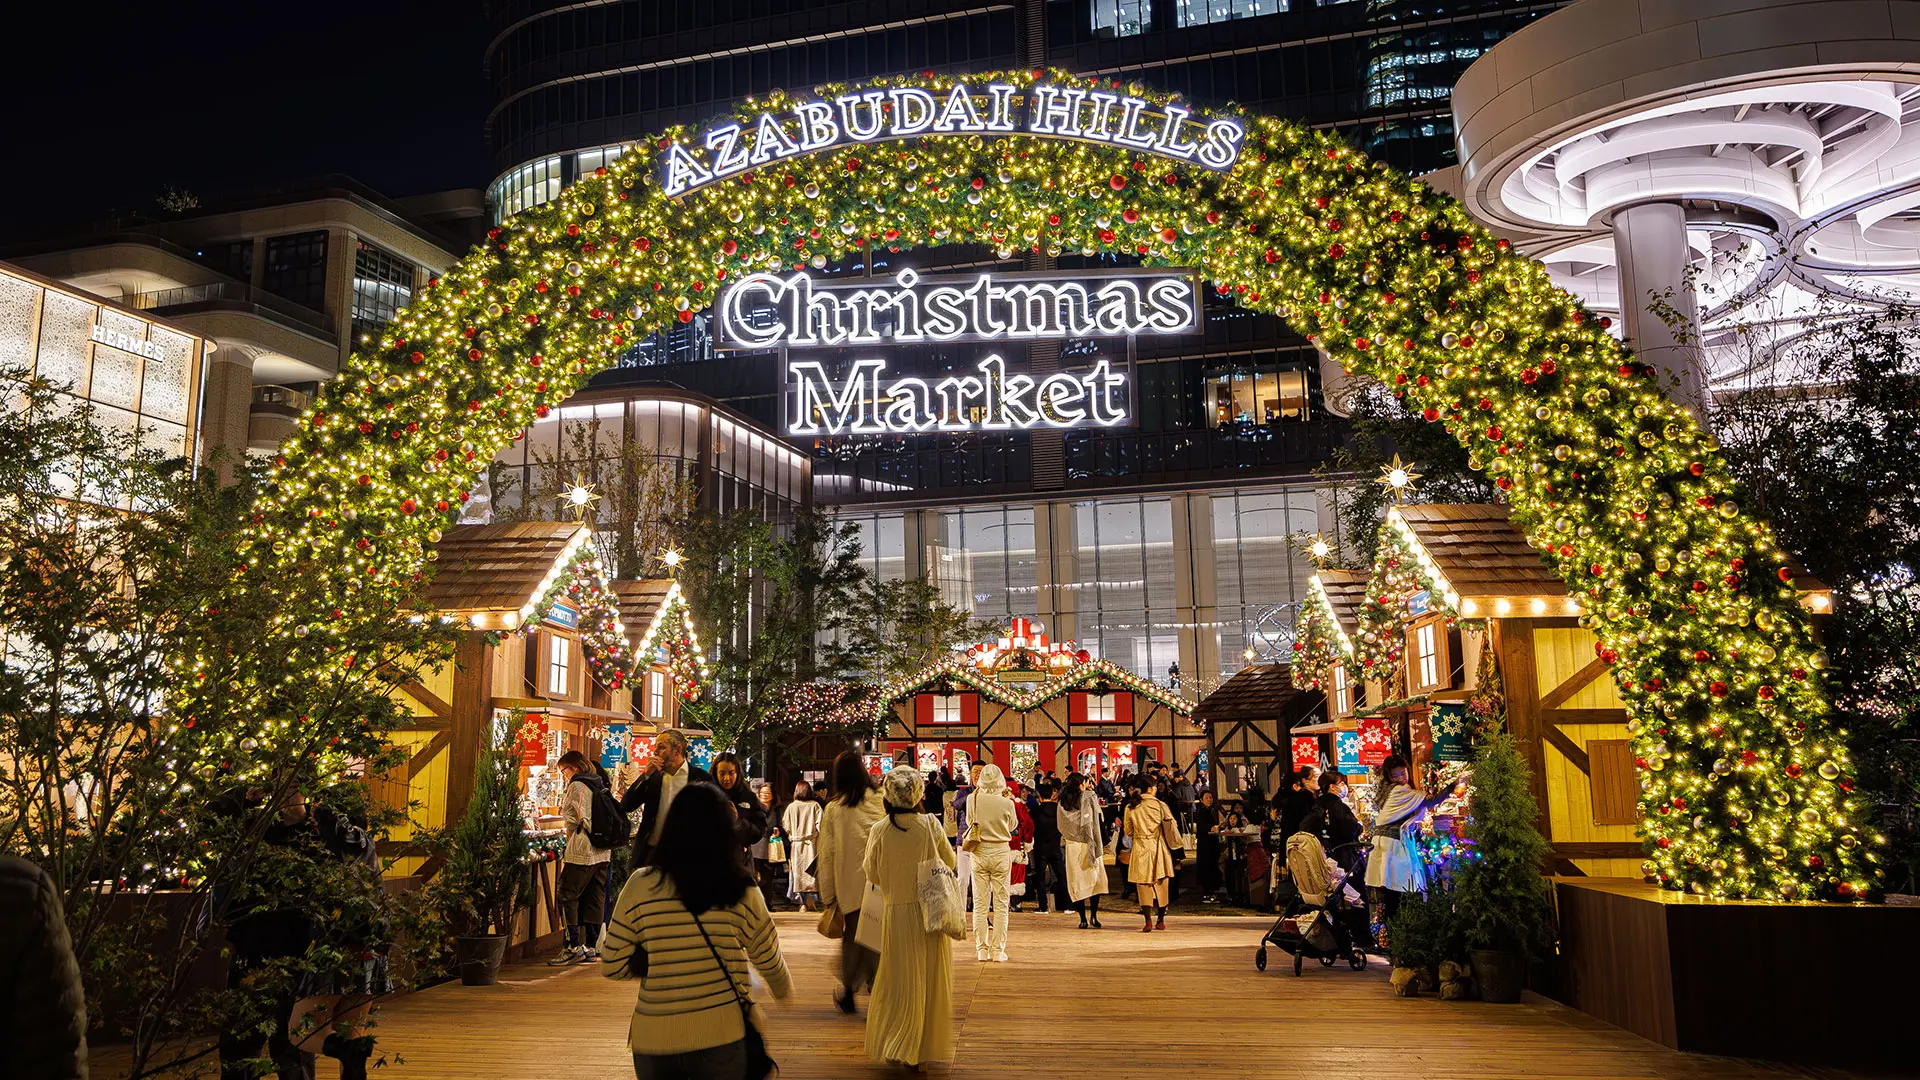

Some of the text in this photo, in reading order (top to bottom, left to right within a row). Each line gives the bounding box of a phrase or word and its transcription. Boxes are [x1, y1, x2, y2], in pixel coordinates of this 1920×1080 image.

[664, 84, 1243, 196] AZABUDAI HILLS
[722, 268, 1193, 348] Christmas
[789, 354, 1126, 436] Market
